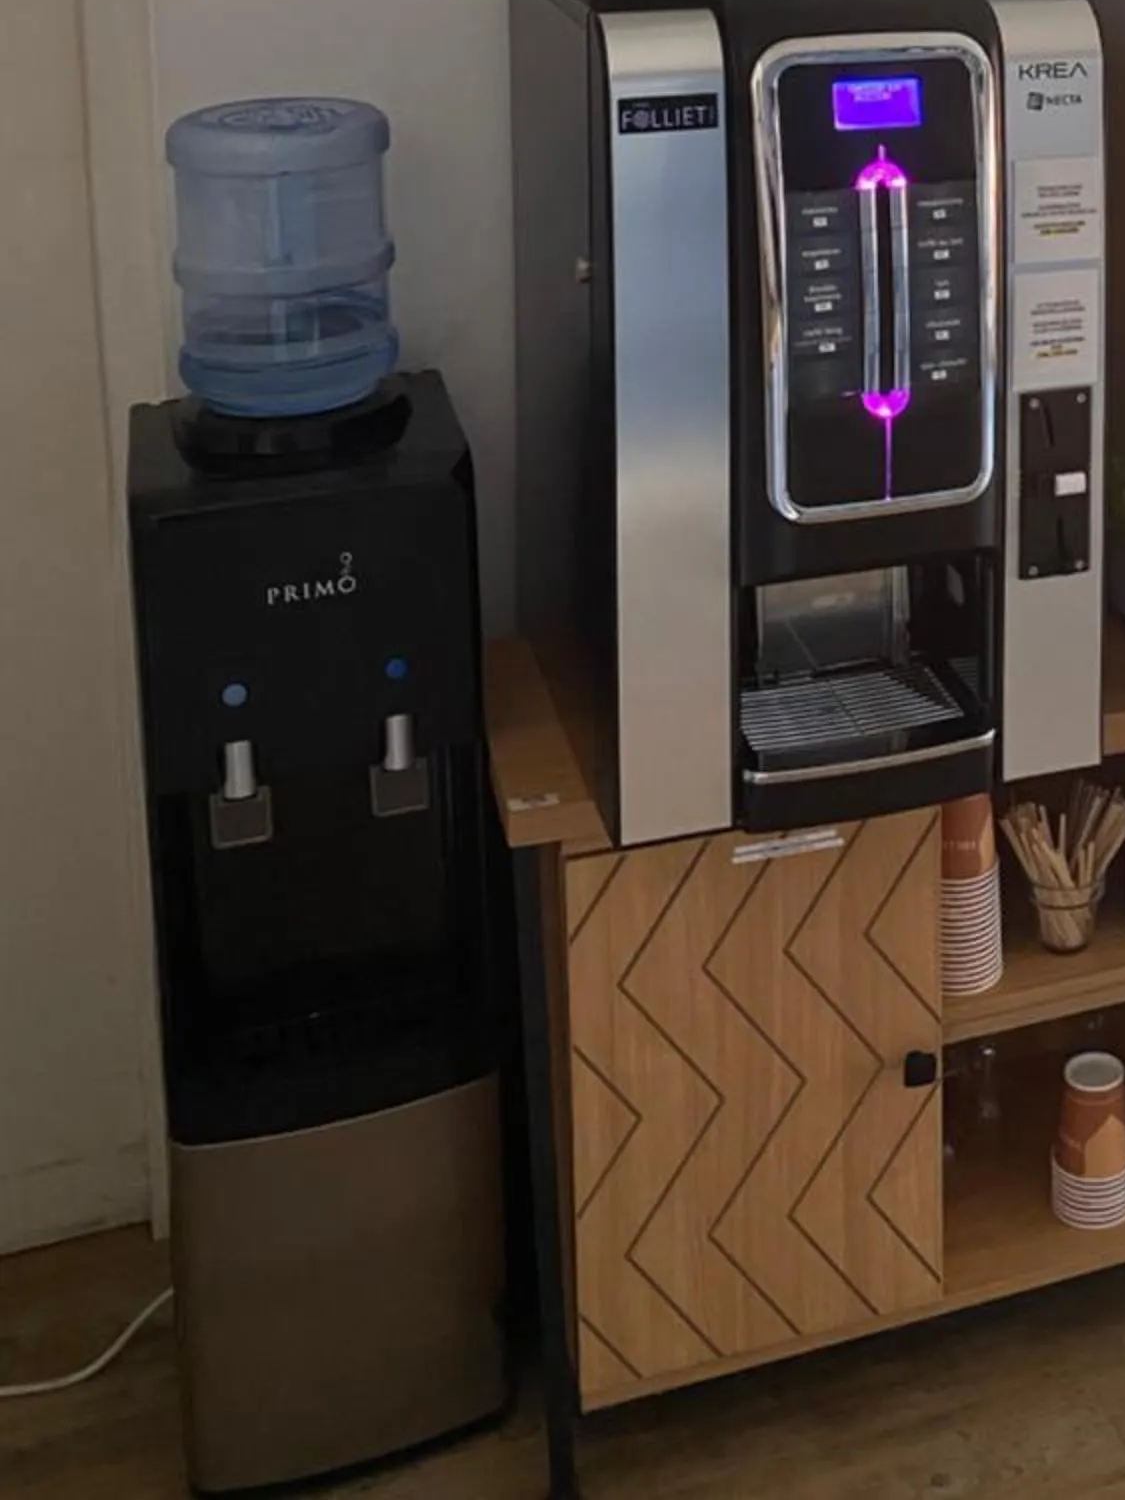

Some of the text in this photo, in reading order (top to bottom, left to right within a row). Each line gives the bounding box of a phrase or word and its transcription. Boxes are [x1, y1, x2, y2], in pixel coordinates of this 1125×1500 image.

[1018, 62, 1088, 80] KREA
[621, 105, 707, 130] FOLLIET
[266, 574, 357, 605] PRIMO
